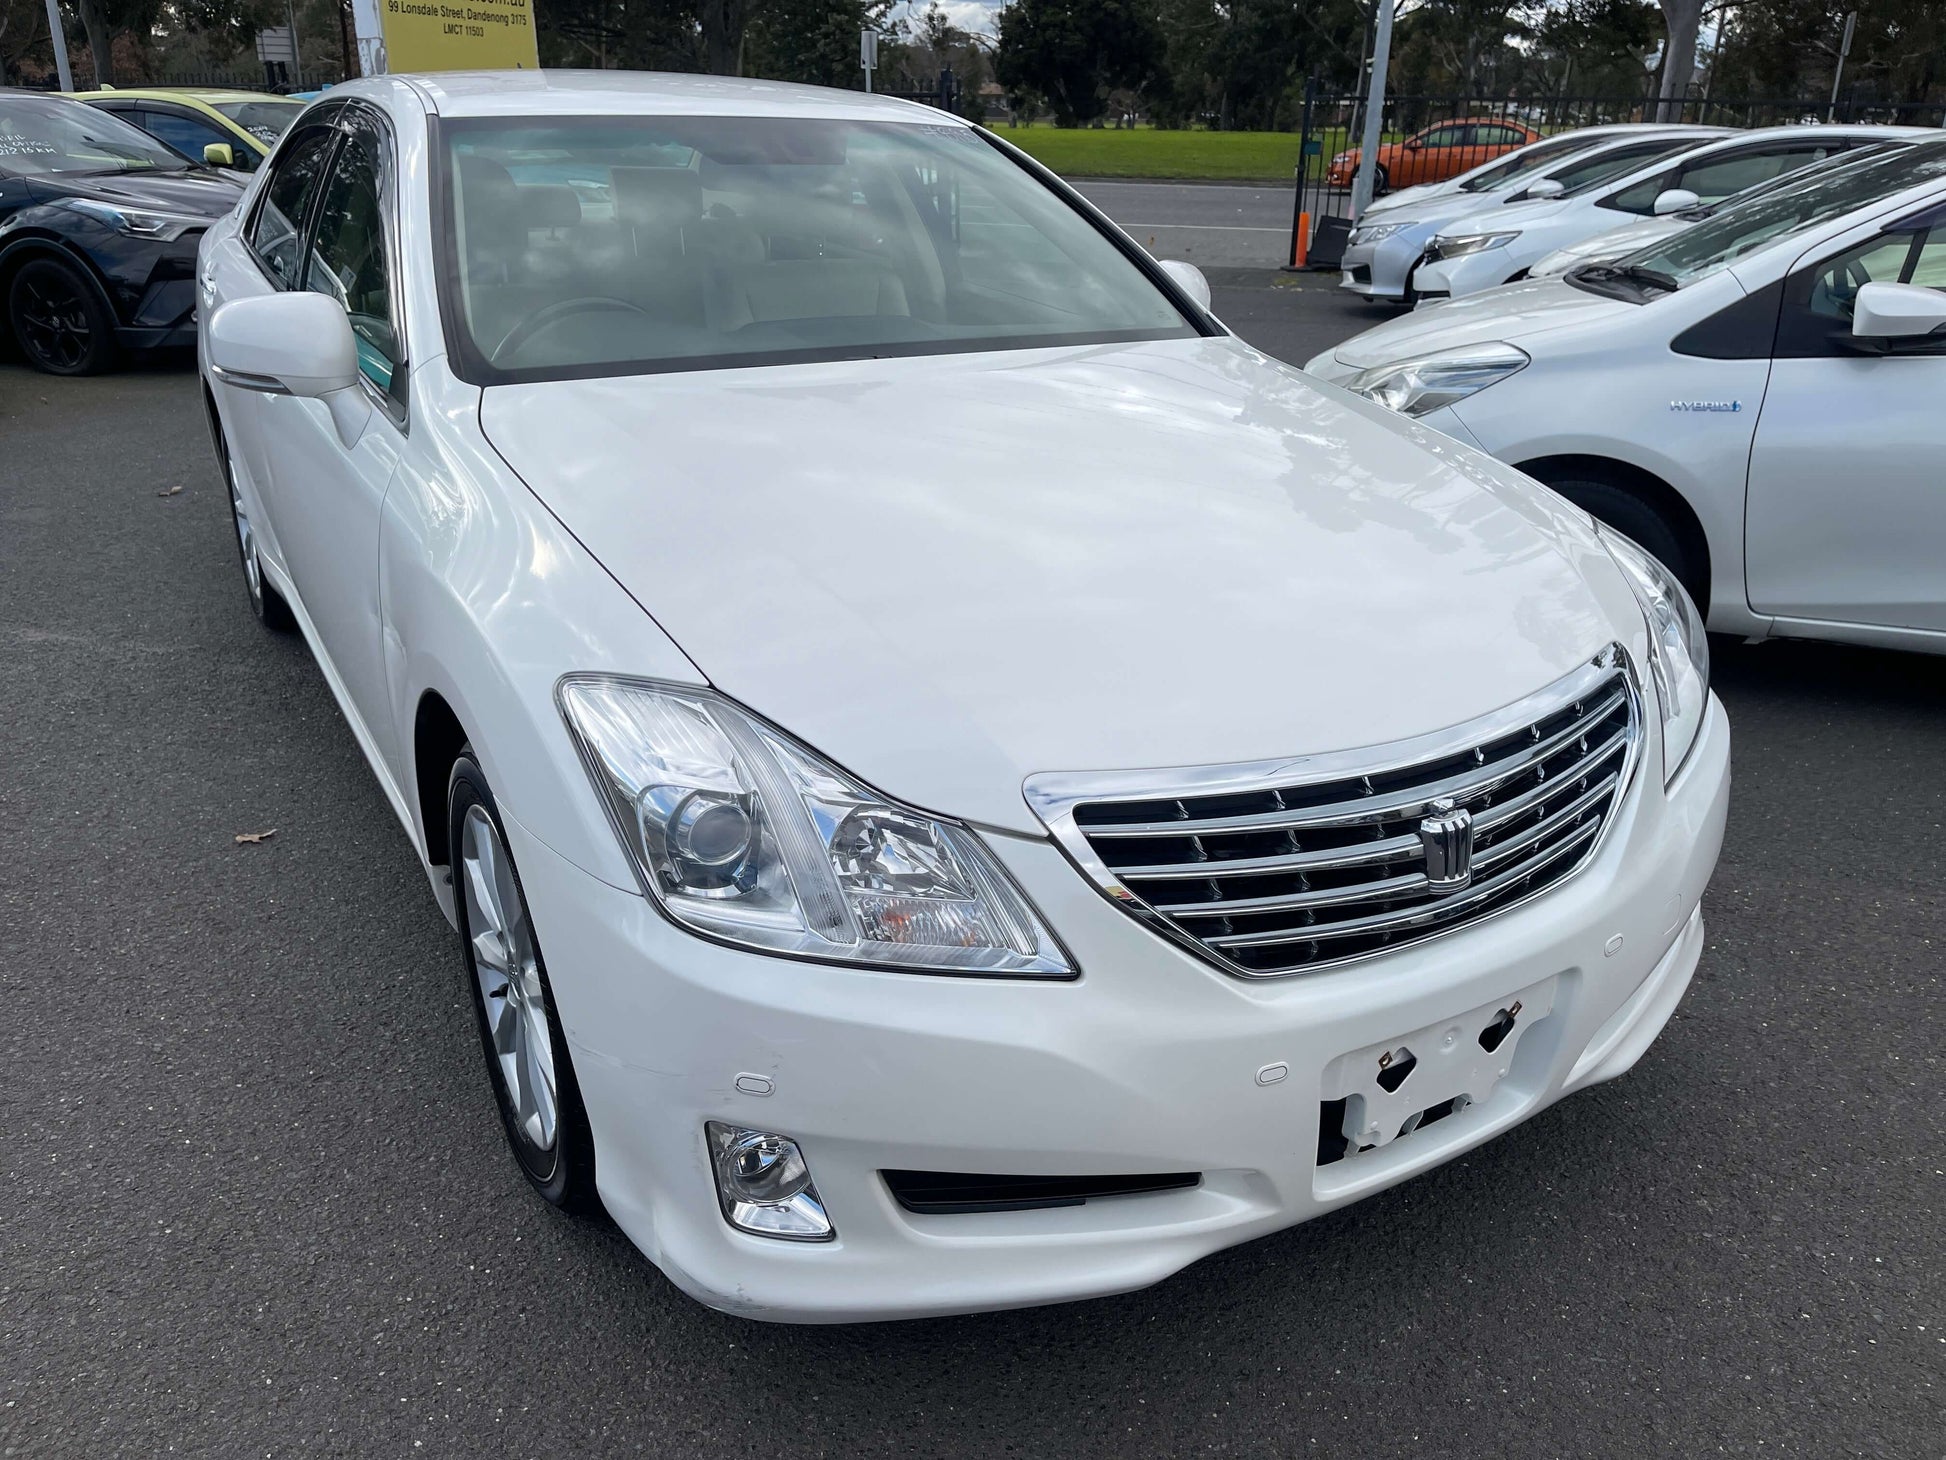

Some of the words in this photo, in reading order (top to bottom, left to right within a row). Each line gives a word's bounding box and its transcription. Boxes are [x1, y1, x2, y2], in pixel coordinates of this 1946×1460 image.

[388, 2, 399, 12] 99
[401, 3, 439, 16] Lonsdale
[441, 7, 466, 20] Street,
[467, 8, 509, 26] Dandenong
[511, 14, 527, 26] 3175
[443, 23, 463, 35] LMCT
[465, 26, 484, 37] 11503
[1670, 401, 1730, 412] HYBRID
